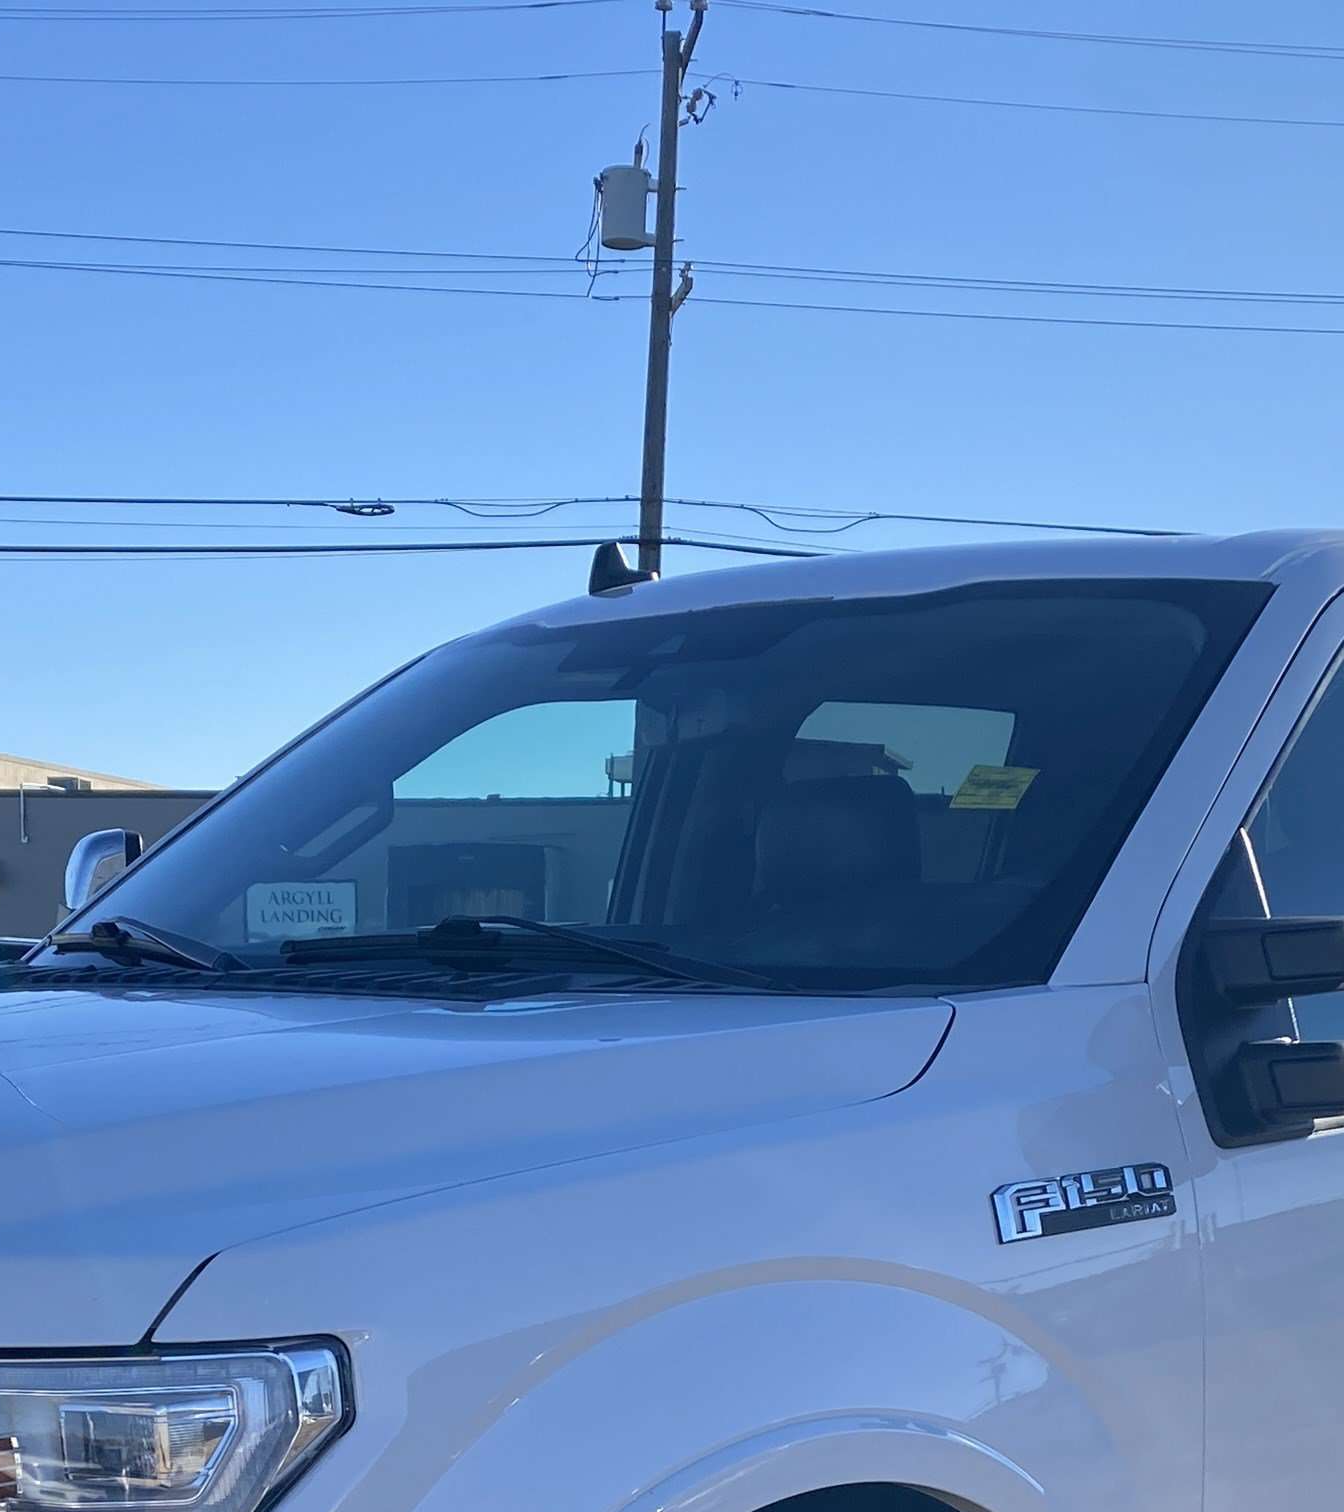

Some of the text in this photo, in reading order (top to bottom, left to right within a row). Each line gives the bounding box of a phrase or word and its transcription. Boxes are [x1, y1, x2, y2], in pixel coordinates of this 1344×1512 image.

[268, 890, 334, 905] ARGYLL
[260, 909, 343, 923] LANDING
[1110, 1199, 1171, 1220] LARIAT
